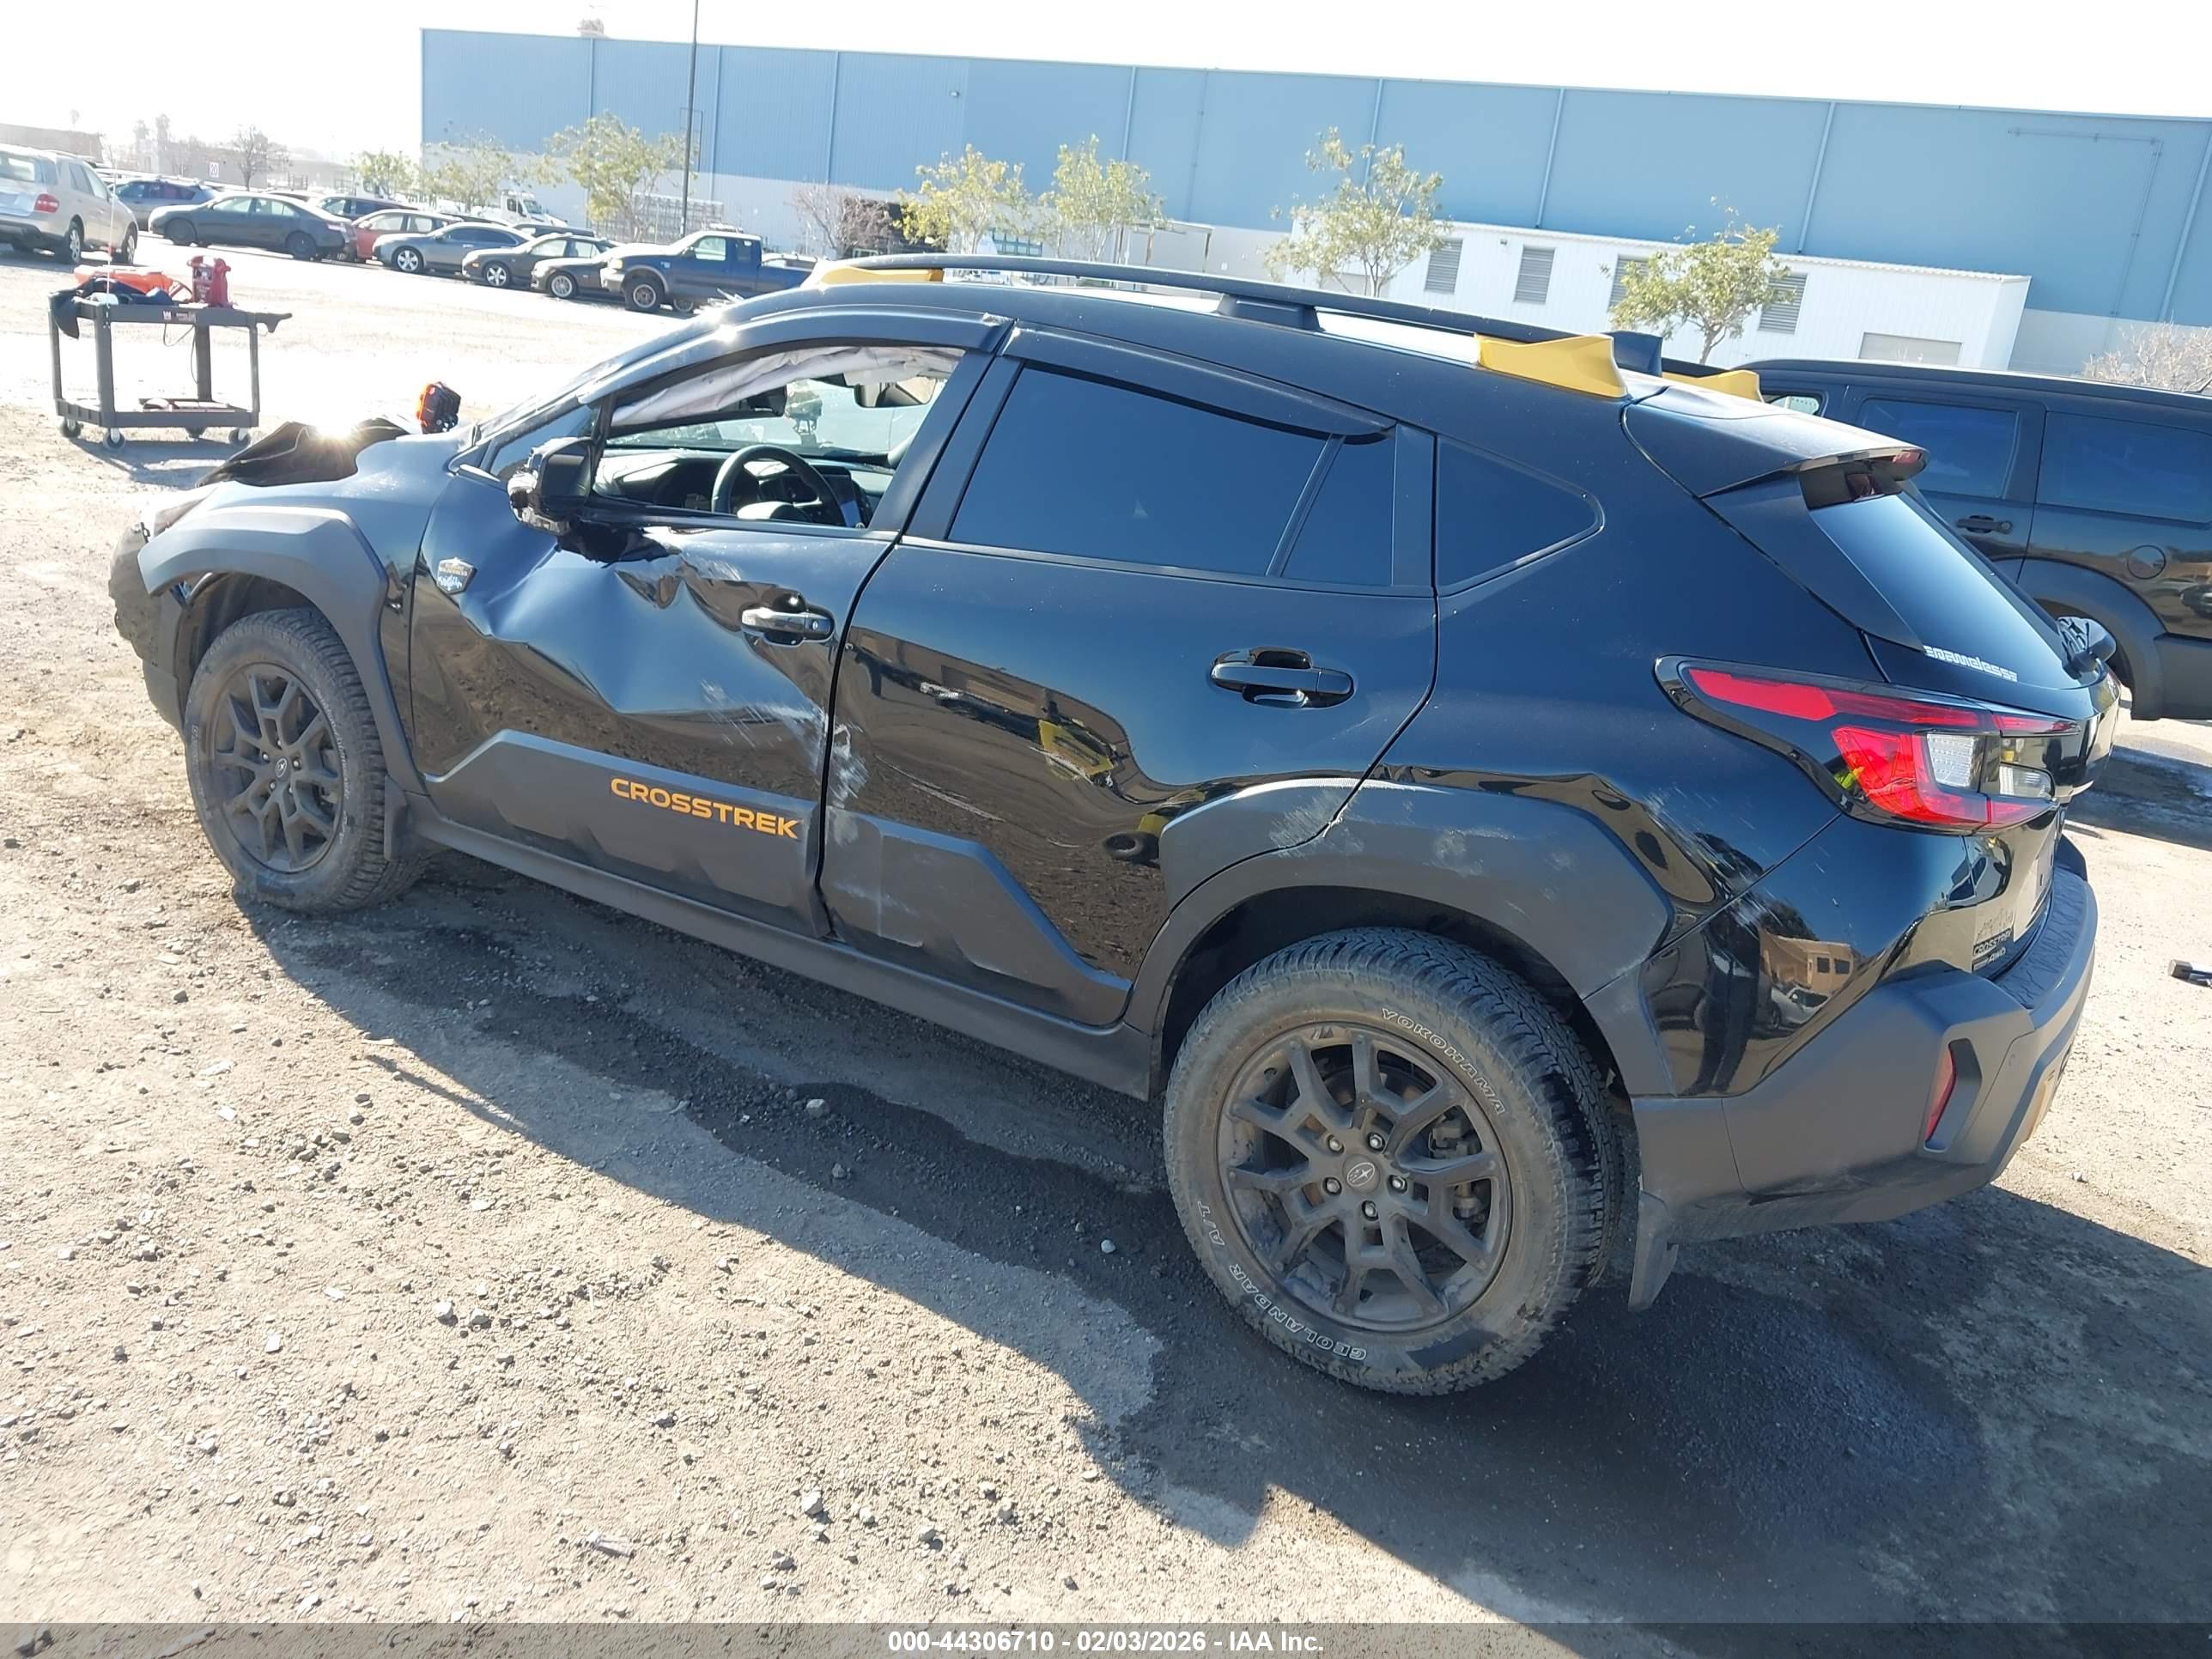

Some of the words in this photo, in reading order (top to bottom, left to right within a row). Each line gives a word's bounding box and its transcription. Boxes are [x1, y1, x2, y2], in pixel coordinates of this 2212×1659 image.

[611, 778, 799, 839] CROSSTREK
[1382, 1007, 1506, 1115] YOKOHAMA
[1197, 1200, 1225, 1246] A/T
[1229, 1264, 1368, 1361] GEOLANDAR
